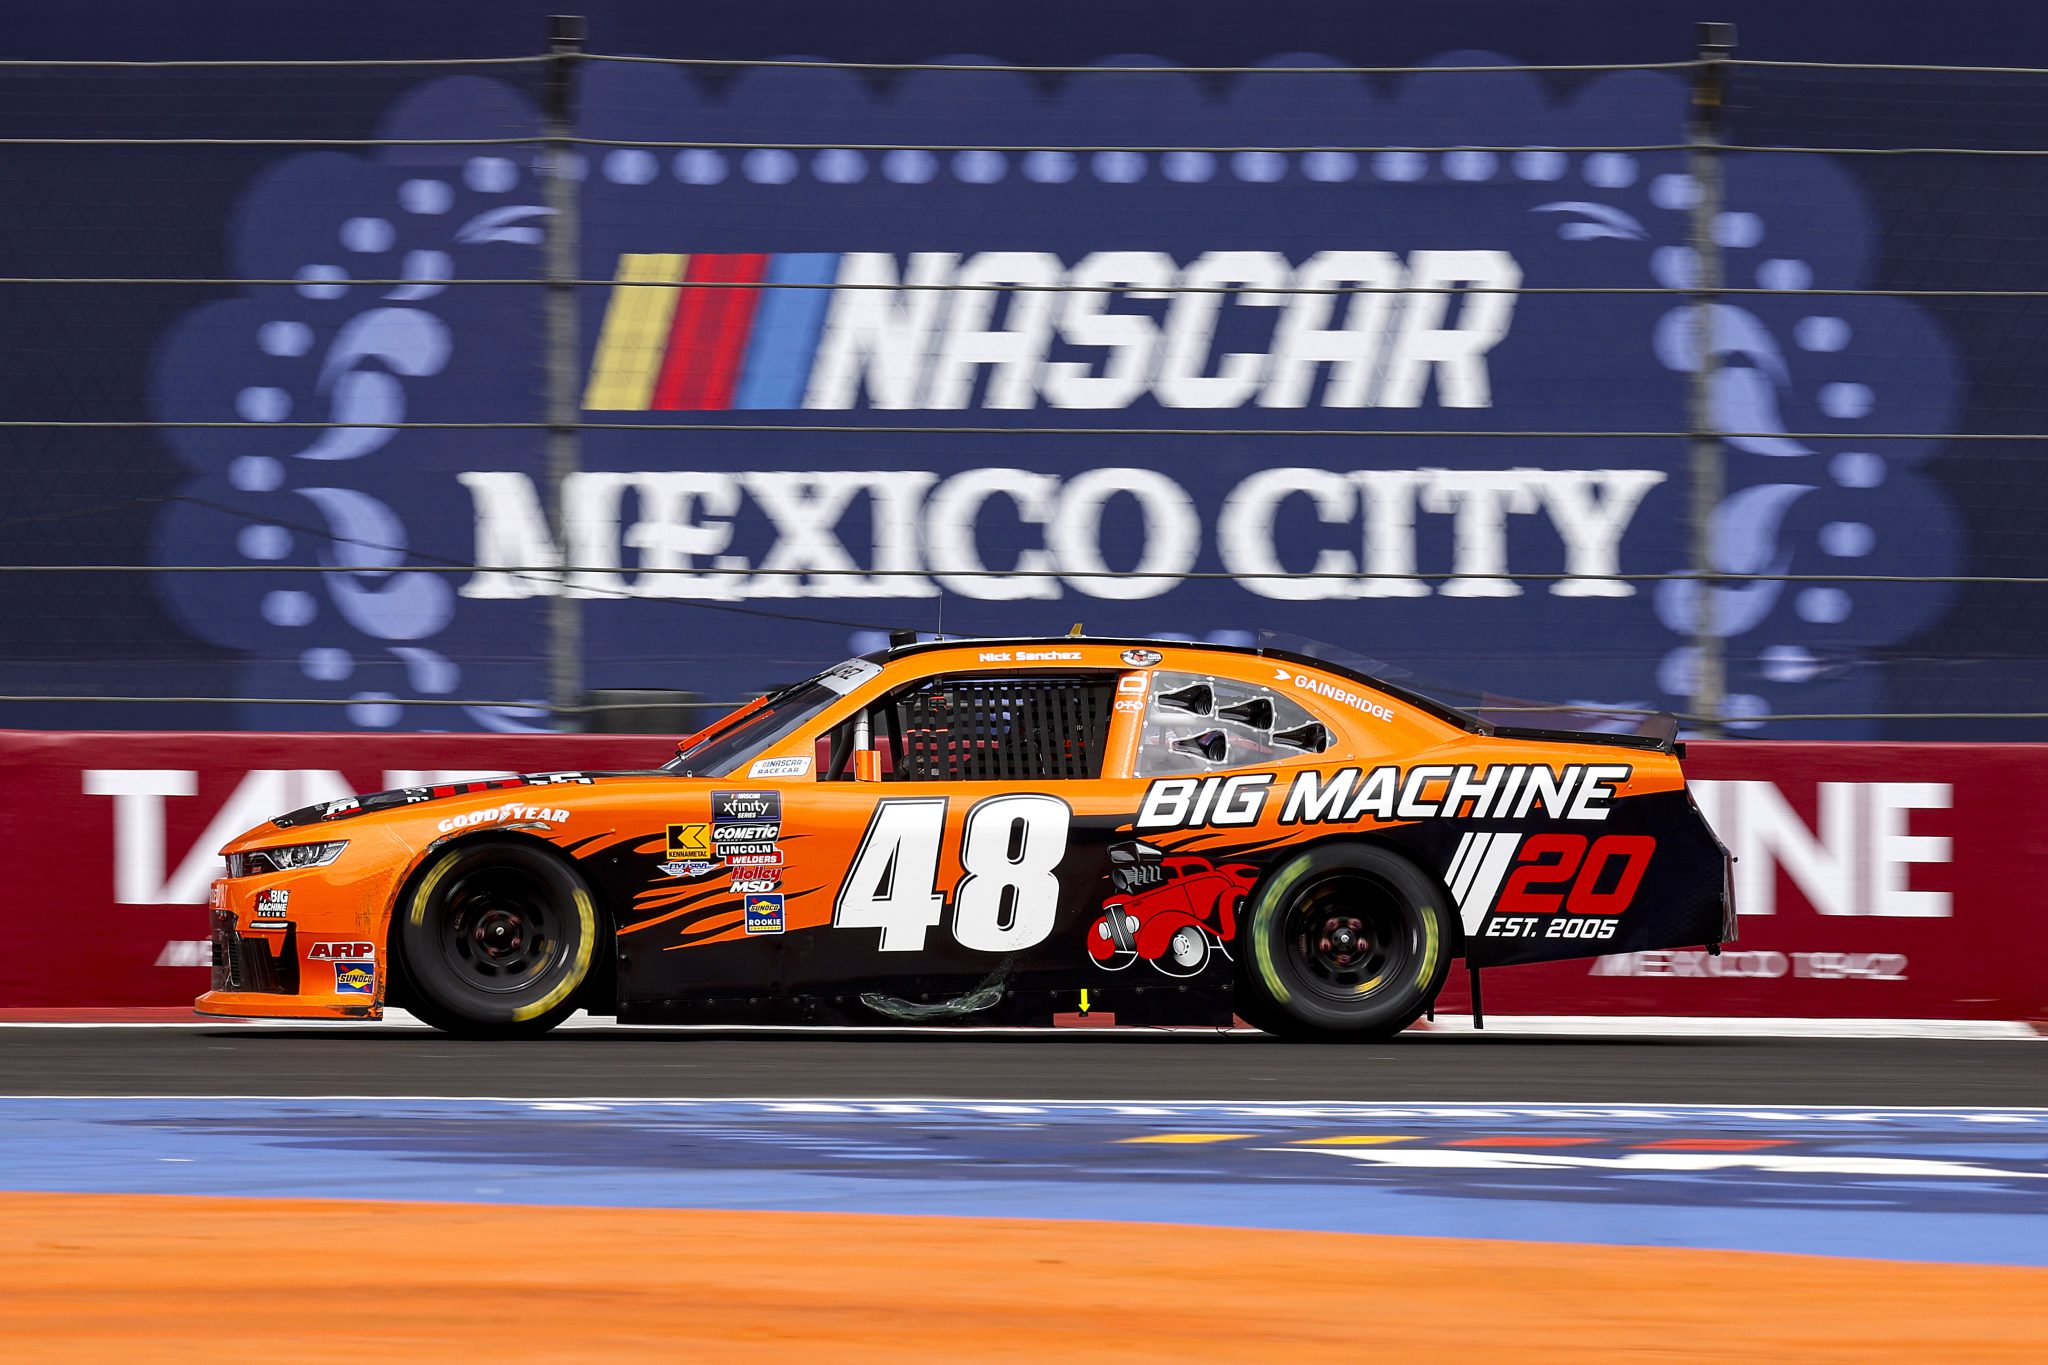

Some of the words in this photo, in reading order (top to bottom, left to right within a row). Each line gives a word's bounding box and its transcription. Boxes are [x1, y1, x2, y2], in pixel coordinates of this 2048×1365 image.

[804, 249, 1523, 410] NASCAR
[457, 467, 1200, 602] MEXICO
[1217, 467, 1669, 601] CITY
[979, 652, 1011, 662] Nick
[1015, 651, 1082, 661] Sanchez
[1294, 674, 1395, 723] GAINBRIDGE
[757, 767, 780, 775] RACE
[1135, 773, 1275, 829] BIG
[1280, 765, 1631, 823] MACHINE
[723, 799, 769, 816] xfinity
[437, 801, 571, 833] GOODYEAR
[713, 826, 779, 840] COMETIC
[720, 844, 771, 855] LINCOLN
[732, 855, 777, 864] WELDERS
[731, 866, 782, 883] Holley
[833, 793, 1071, 953] 48
[1495, 833, 1657, 915] 20
[729, 880, 775, 893] MSD
[270, 890, 289, 903] BIG
[258, 903, 287, 911] MACHINE
[750, 904, 780, 912] SUNOCO
[748, 918, 782, 926] ROOKIE
[1485, 917, 1537, 937] EST.
[1545, 918, 1619, 939] 2005
[309, 943, 374, 958] ARP
[339, 973, 373, 984] SUNOCO
